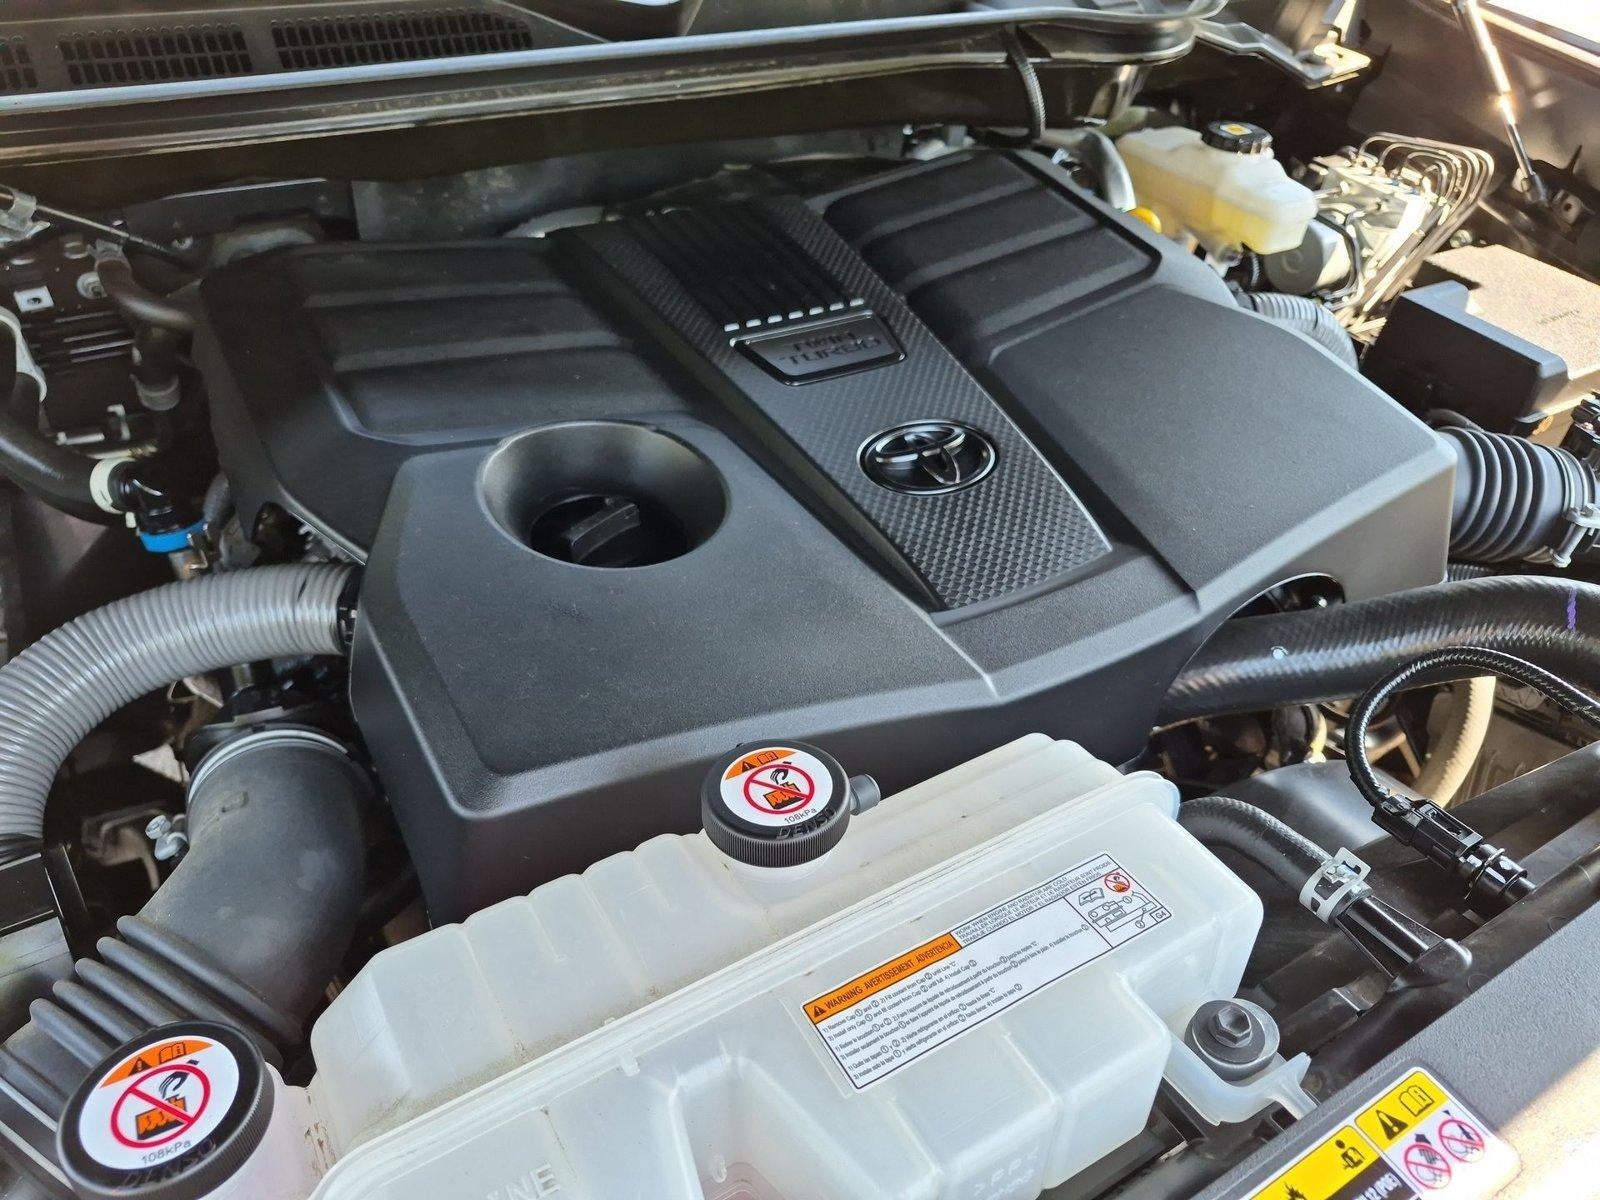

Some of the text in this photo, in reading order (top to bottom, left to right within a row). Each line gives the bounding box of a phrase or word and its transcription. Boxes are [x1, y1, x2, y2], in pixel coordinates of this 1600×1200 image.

[777, 805, 837, 840] DENSO
[783, 807, 818, 824] 108kPa
[954, 924, 971, 935] WORK
[971, 916, 988, 927] WHEN
[987, 906, 1007, 918] ENGINE
[1017, 888, 1042, 903] RADIATOR
[1041, 883, 1052, 891] ARE
[962, 929, 986, 944] TRABAJE
[985, 918, 1009, 932] CUANDO
[1014, 905, 1034, 917] MOTOR
[1042, 886, 1070, 902] RADIADOR
[1018, 896, 1040, 908] MOTEUR
[1154, 910, 1166, 919] G4
[824, 939, 953, 1010] WARNING AVERTISSEMENT ADVERTENCIA
[827, 1018, 846, 1030] Remove
[845, 1013, 856, 1021] Cap
[915, 976, 926, 984] Cap
[833, 1028, 846, 1038] Install
[846, 1023, 856, 1032] only
[855, 1018, 866, 1027] Cap
[872, 1009, 882, 1017] and
[911, 989, 922, 997] Cap
[959, 963, 970, 971] Cap
[141, 1139, 192, 1165] 108kPa
